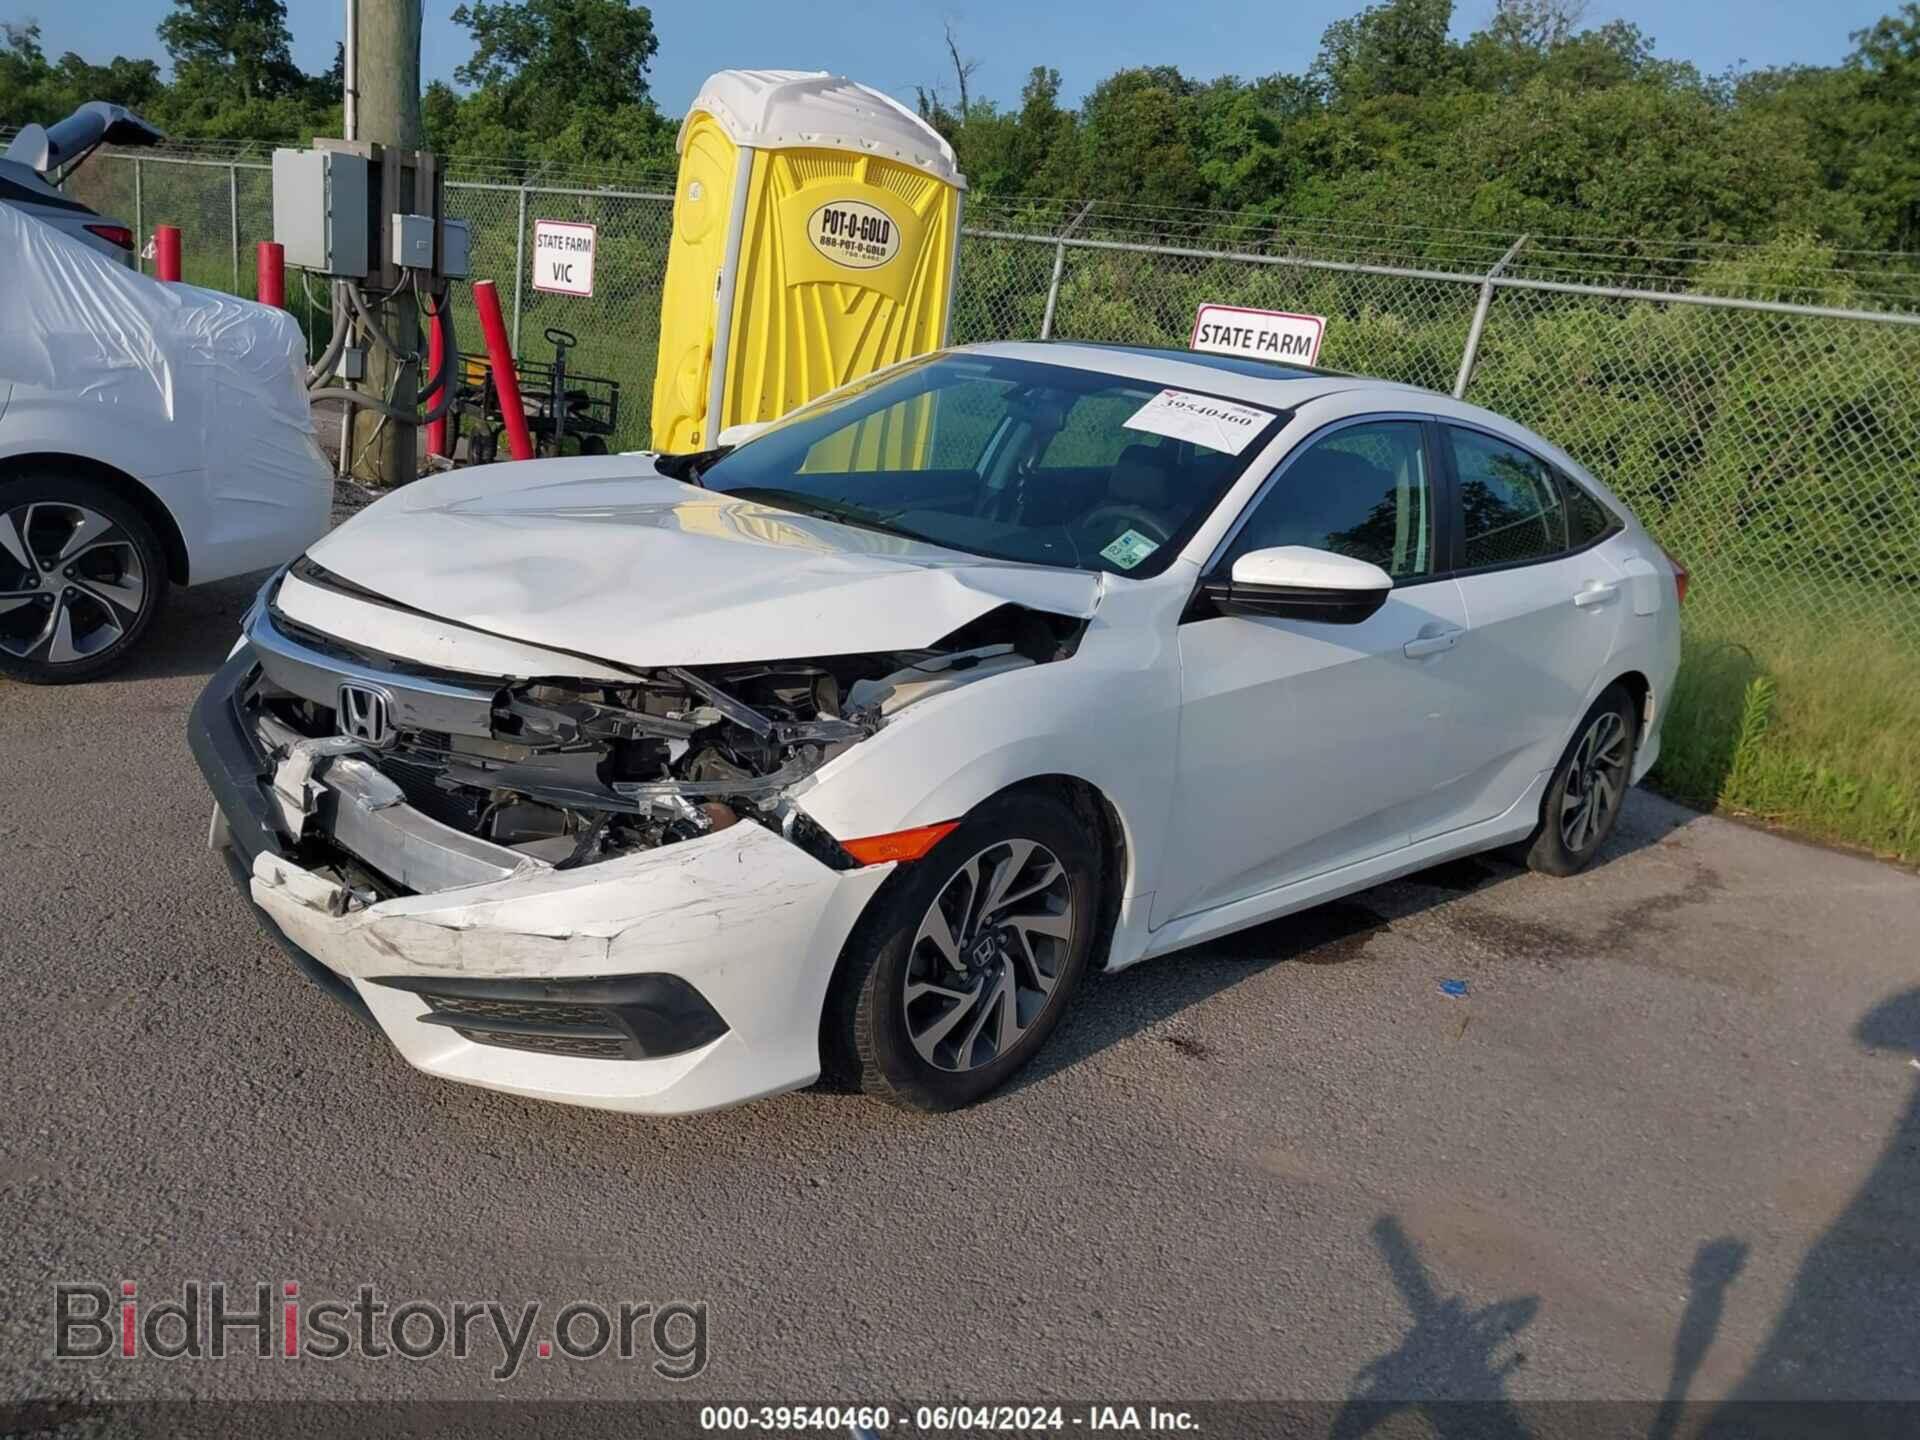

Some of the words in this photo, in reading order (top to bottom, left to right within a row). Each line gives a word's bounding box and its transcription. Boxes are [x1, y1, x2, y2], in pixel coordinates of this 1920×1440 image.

[822, 208, 890, 244] POT-O-GOLD
[538, 234, 564, 250] STATE
[565, 236, 591, 253] FARM
[552, 262, 573, 283] VIC
[1200, 324, 1254, 349] STATE
[1256, 330, 1312, 357] FARM
